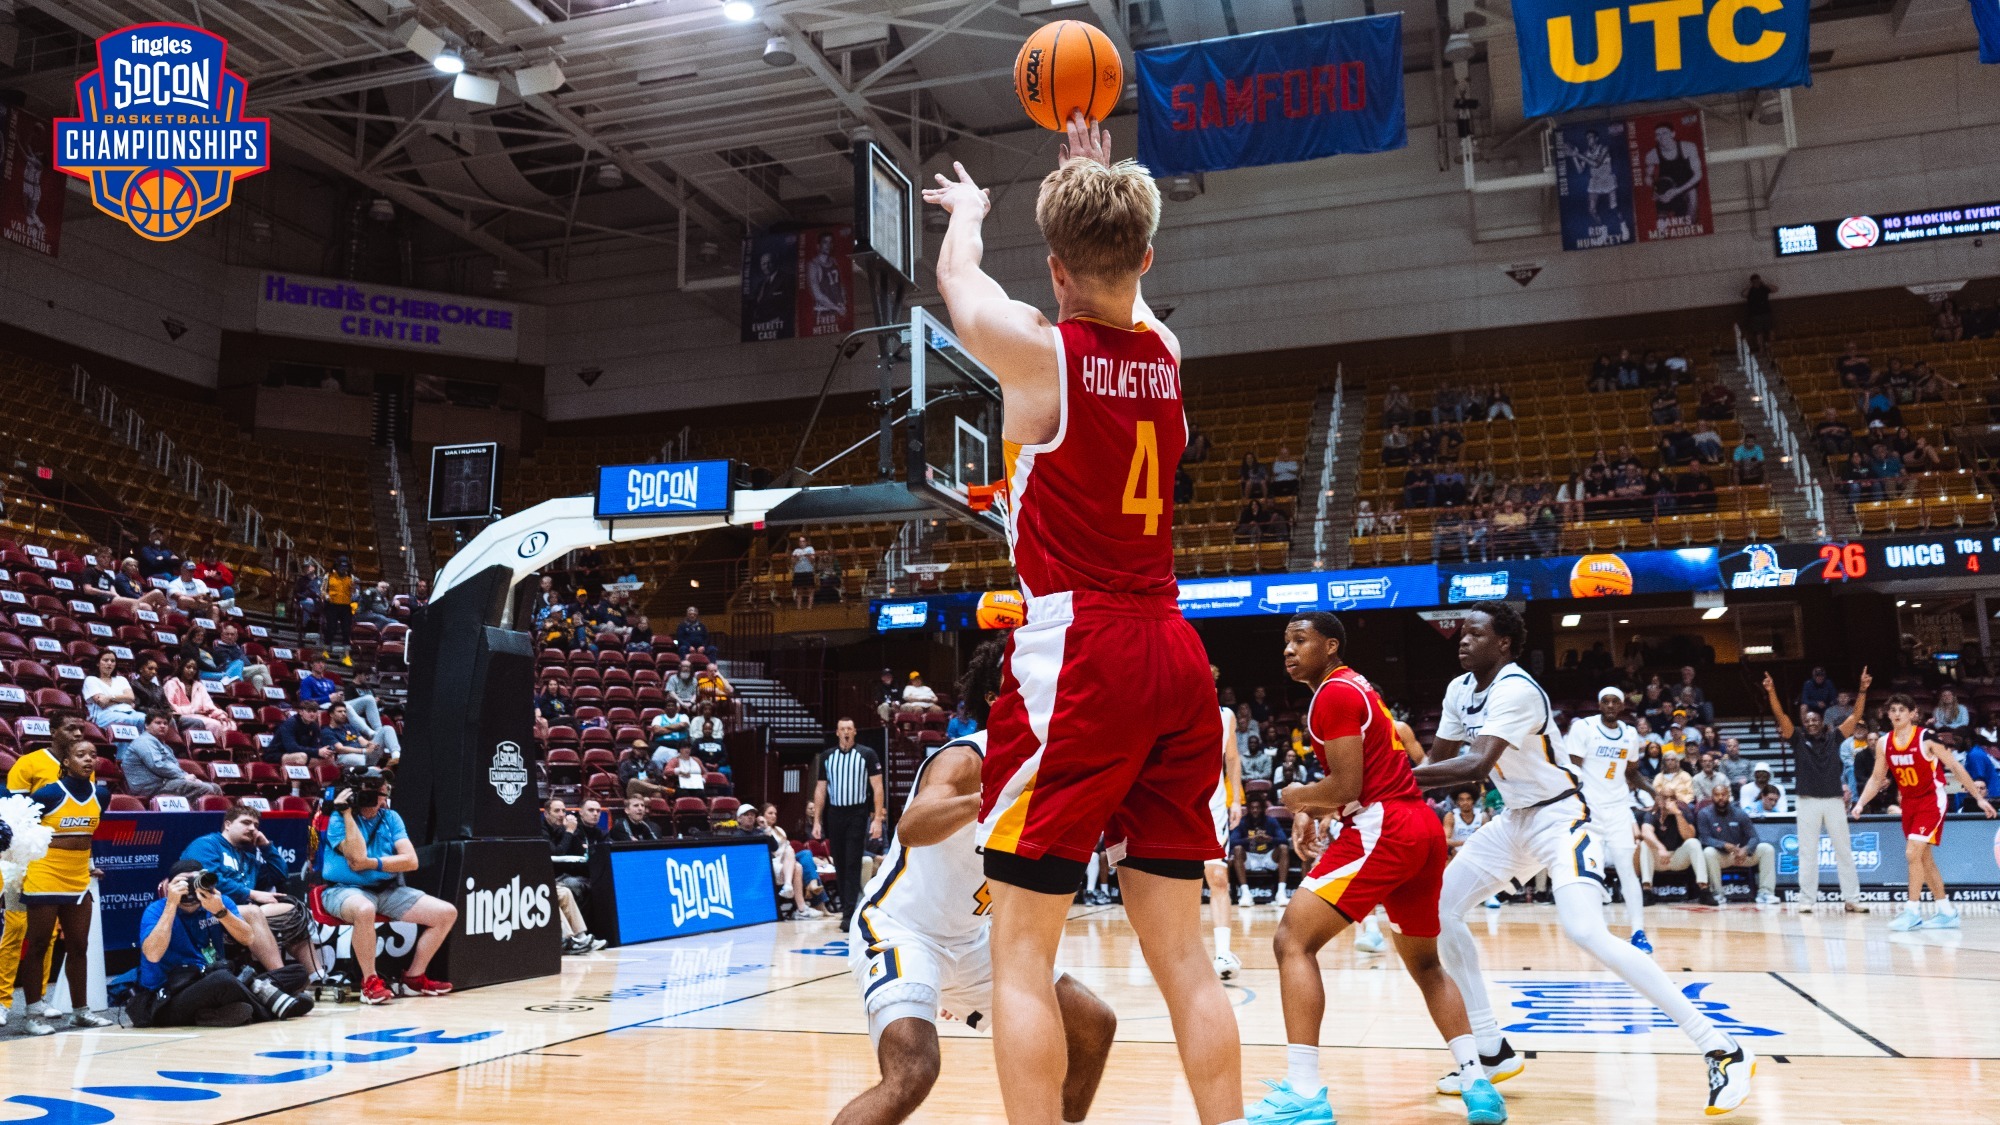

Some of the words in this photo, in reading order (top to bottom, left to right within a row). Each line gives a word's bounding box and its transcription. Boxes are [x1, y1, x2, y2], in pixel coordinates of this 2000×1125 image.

[1547, 0, 1786, 84] UTC
[1026, 48, 1042, 103] NCAA
[1170, 60, 1366, 132] SAMFORD
[1883, 217, 1901, 229] NO
[1904, 209, 1962, 227] SMOKING
[4, 227, 52, 255] WHITESIDE
[1884, 228, 1925, 242] Anywhere
[1926, 228, 1937, 237] on
[1939, 224, 1953, 236] the
[1954, 223, 1980, 234] venue
[827, 270, 839, 286] 17
[266, 274, 366, 312] Harrah's
[369, 294, 513, 330] CHEROKEE
[340, 316, 441, 345] CENTER
[758, 330, 777, 340] CASE
[1122, 420, 1164, 536] 4
[1818, 543, 1868, 579] 26
[1885, 543, 1946, 568] UNCG
[1966, 554, 1980, 573] 4
[1438, 620, 1456, 629] 124
[67, 666, 81, 677] AVL
[6, 689, 21, 699] AVL
[33, 722, 50, 732] AVL
[121, 728, 136, 737] AVL
[198, 731, 211, 741] AVL
[1596, 745, 1628, 759] UNCG
[223, 765, 237, 775] AVL
[1605, 761, 1617, 779] 2
[1895, 767, 1919, 787] 30
[169, 800, 185, 809] AVL
[60, 816, 98, 827] UNCG
[95, 855, 133, 864] ASHEVILLE
[134, 854, 159, 863] SPORTS
[100, 893, 128, 903] ATTON
[129, 892, 154, 902] ALLEN
[466, 874, 551, 941] ingles
